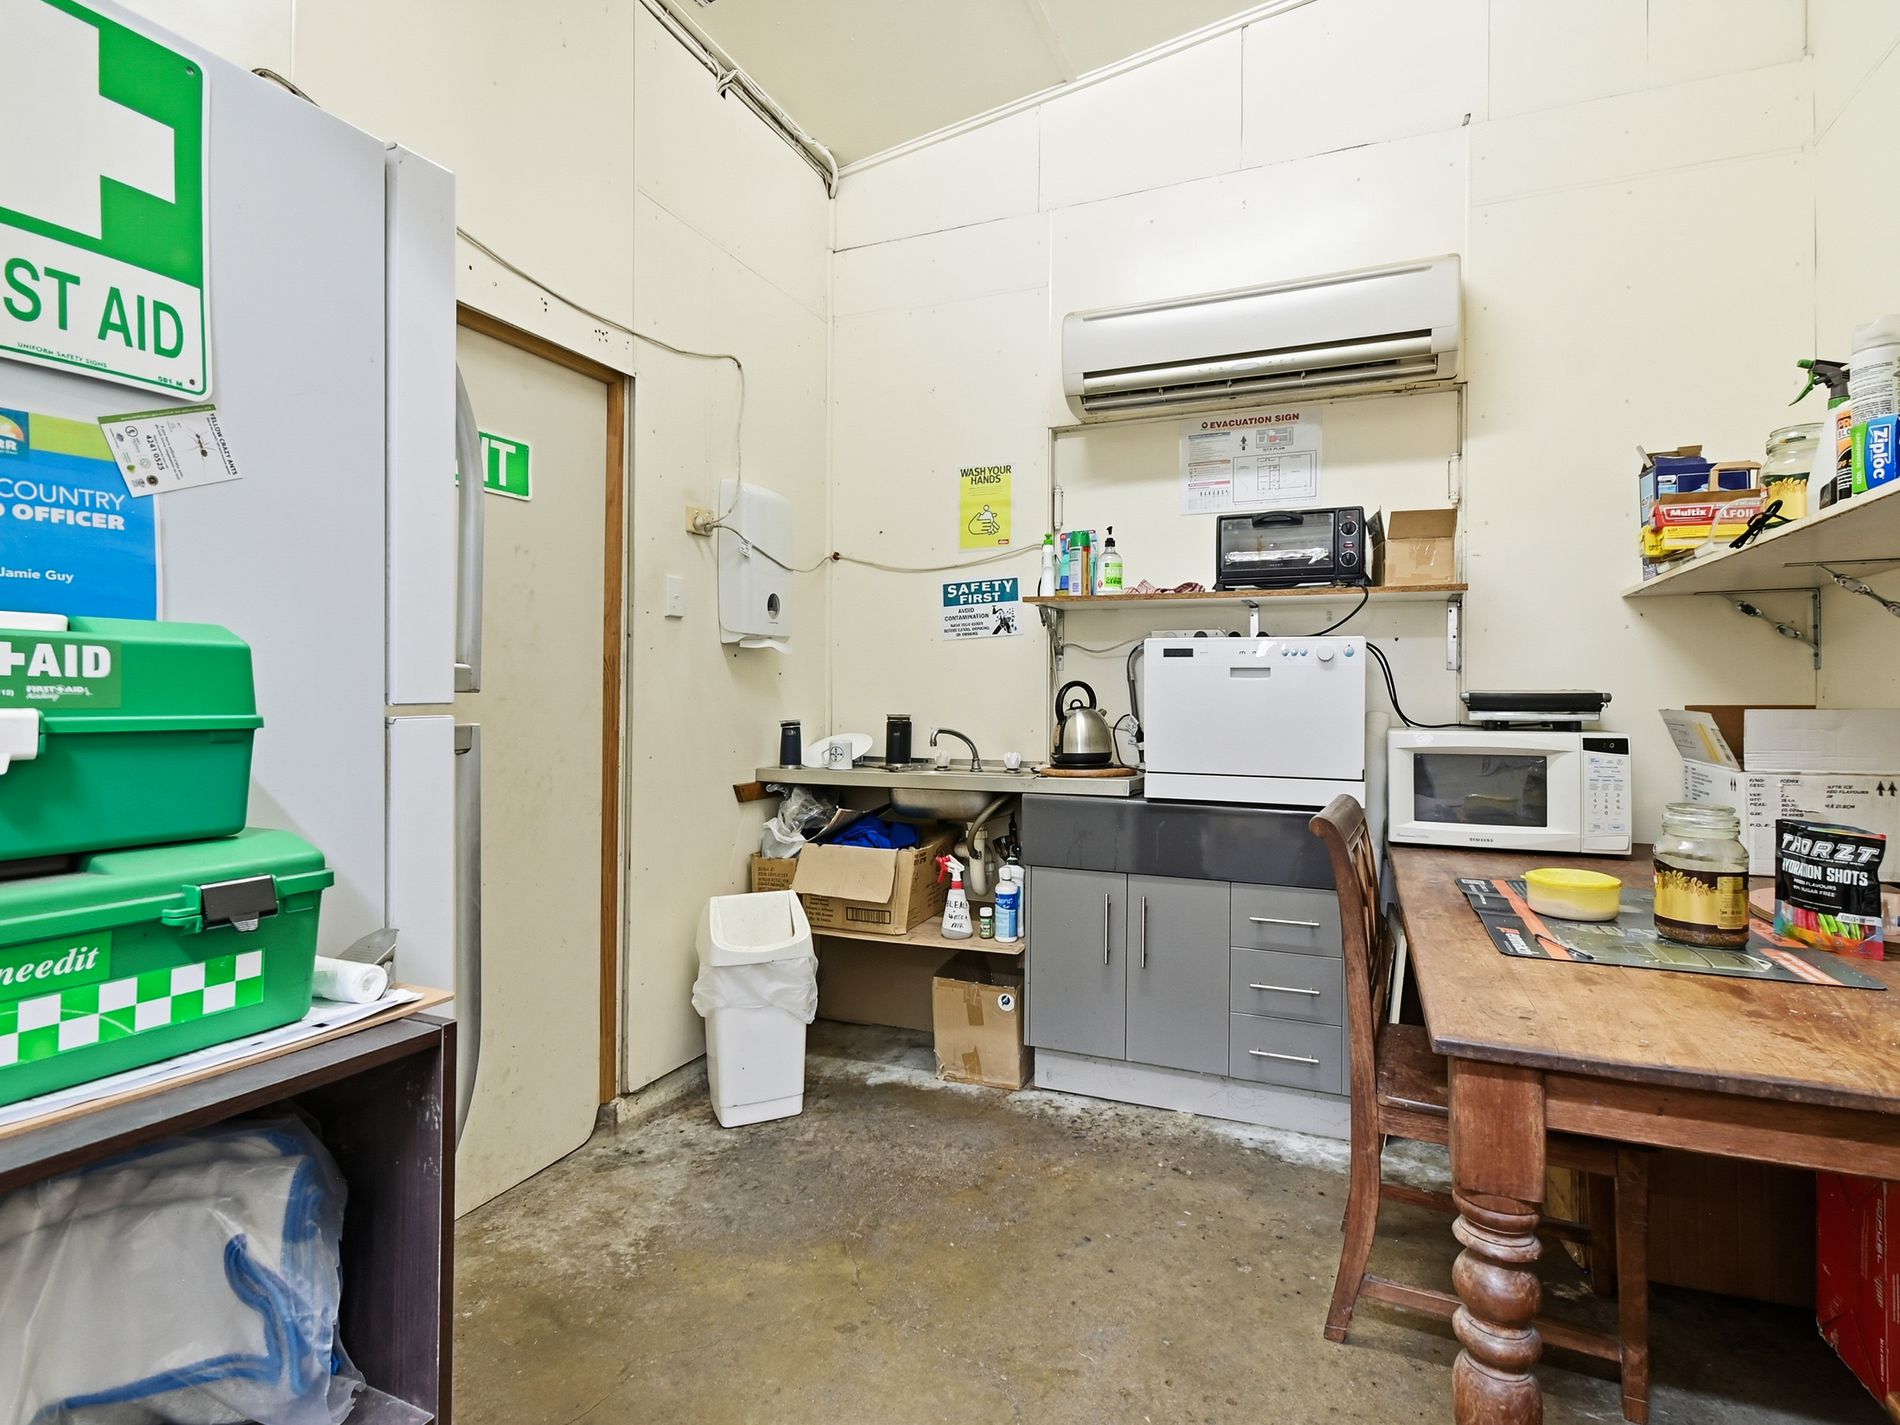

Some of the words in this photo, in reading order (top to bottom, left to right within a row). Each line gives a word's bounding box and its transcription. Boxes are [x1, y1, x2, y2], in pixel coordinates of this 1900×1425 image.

[3, 257, 81, 331] ST
[97, 286, 184, 359] AID
[17, 342, 54, 355] UNIFORM
[57, 351, 82, 362] SAFETY
[85, 358, 108, 368] SIGNS
[1209, 416, 1272, 429] EVACUATION
[1274, 413, 1300, 422] SIGN
[209, 413, 224, 438] YELLOW
[219, 438, 232, 459] CRAZY
[227, 459, 238, 476] ANTS
[1868, 427, 1889, 480] Ziploc
[960, 467, 986, 478] WASH
[987, 464, 1012, 475] YOUR
[970, 474, 1002, 485] HANDS
[0, 477, 126, 511] COUNTRY
[11, 503, 125, 531] OFFICER
[1669, 508, 1707, 517] Multix
[0, 566, 41, 579] Jamie
[44, 569, 74, 584] Guy
[946, 580, 1013, 598] SAFETY
[959, 592, 1001, 604] FIRST
[944, 613, 989, 622] CONTAMINATION
[27, 643, 112, 678] AID
[1781, 832, 1880, 864] THORZT
[1805, 881, 1837, 891] FLAVOURS
[1826, 867, 1869, 887] SHOTS
[0, 946, 100, 986] needit
